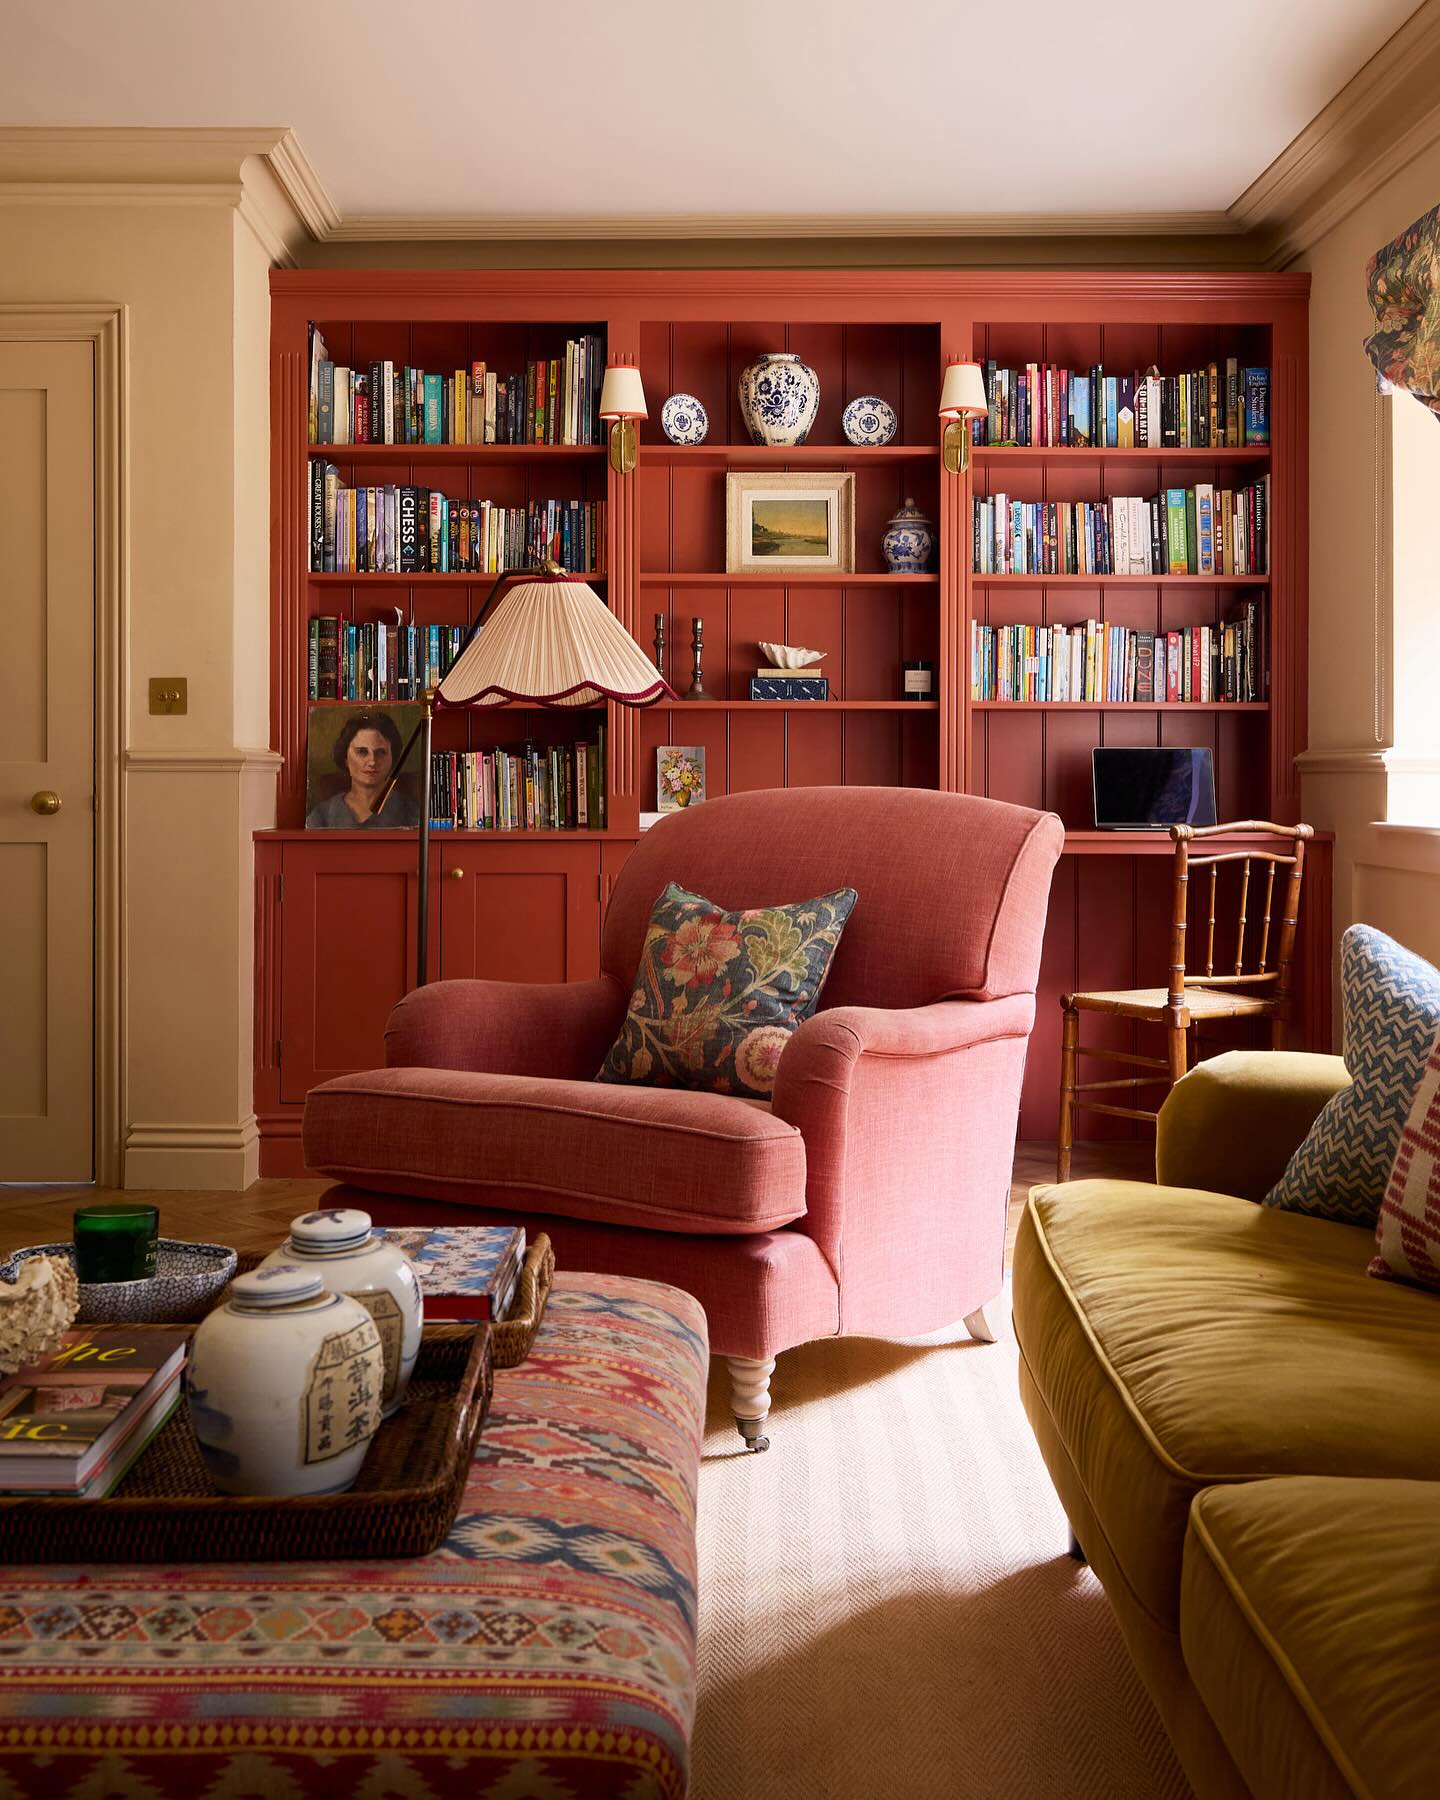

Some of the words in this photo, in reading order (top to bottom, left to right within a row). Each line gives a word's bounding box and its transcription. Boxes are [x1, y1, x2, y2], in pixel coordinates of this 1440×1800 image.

[475, 367, 483, 394] RIVERS
[1139, 384, 1147, 403] SON
[1251, 396, 1260, 428] Students
[1258, 387, 1267, 425] Dictionary
[1139, 407, 1147, 441] HAMAS
[402, 497, 415, 543] CHESS
[1256, 484, 1264, 531] Pathfinders
[53, 1343, 136, 1361] he
[0, 1417, 68, 1440] ic
